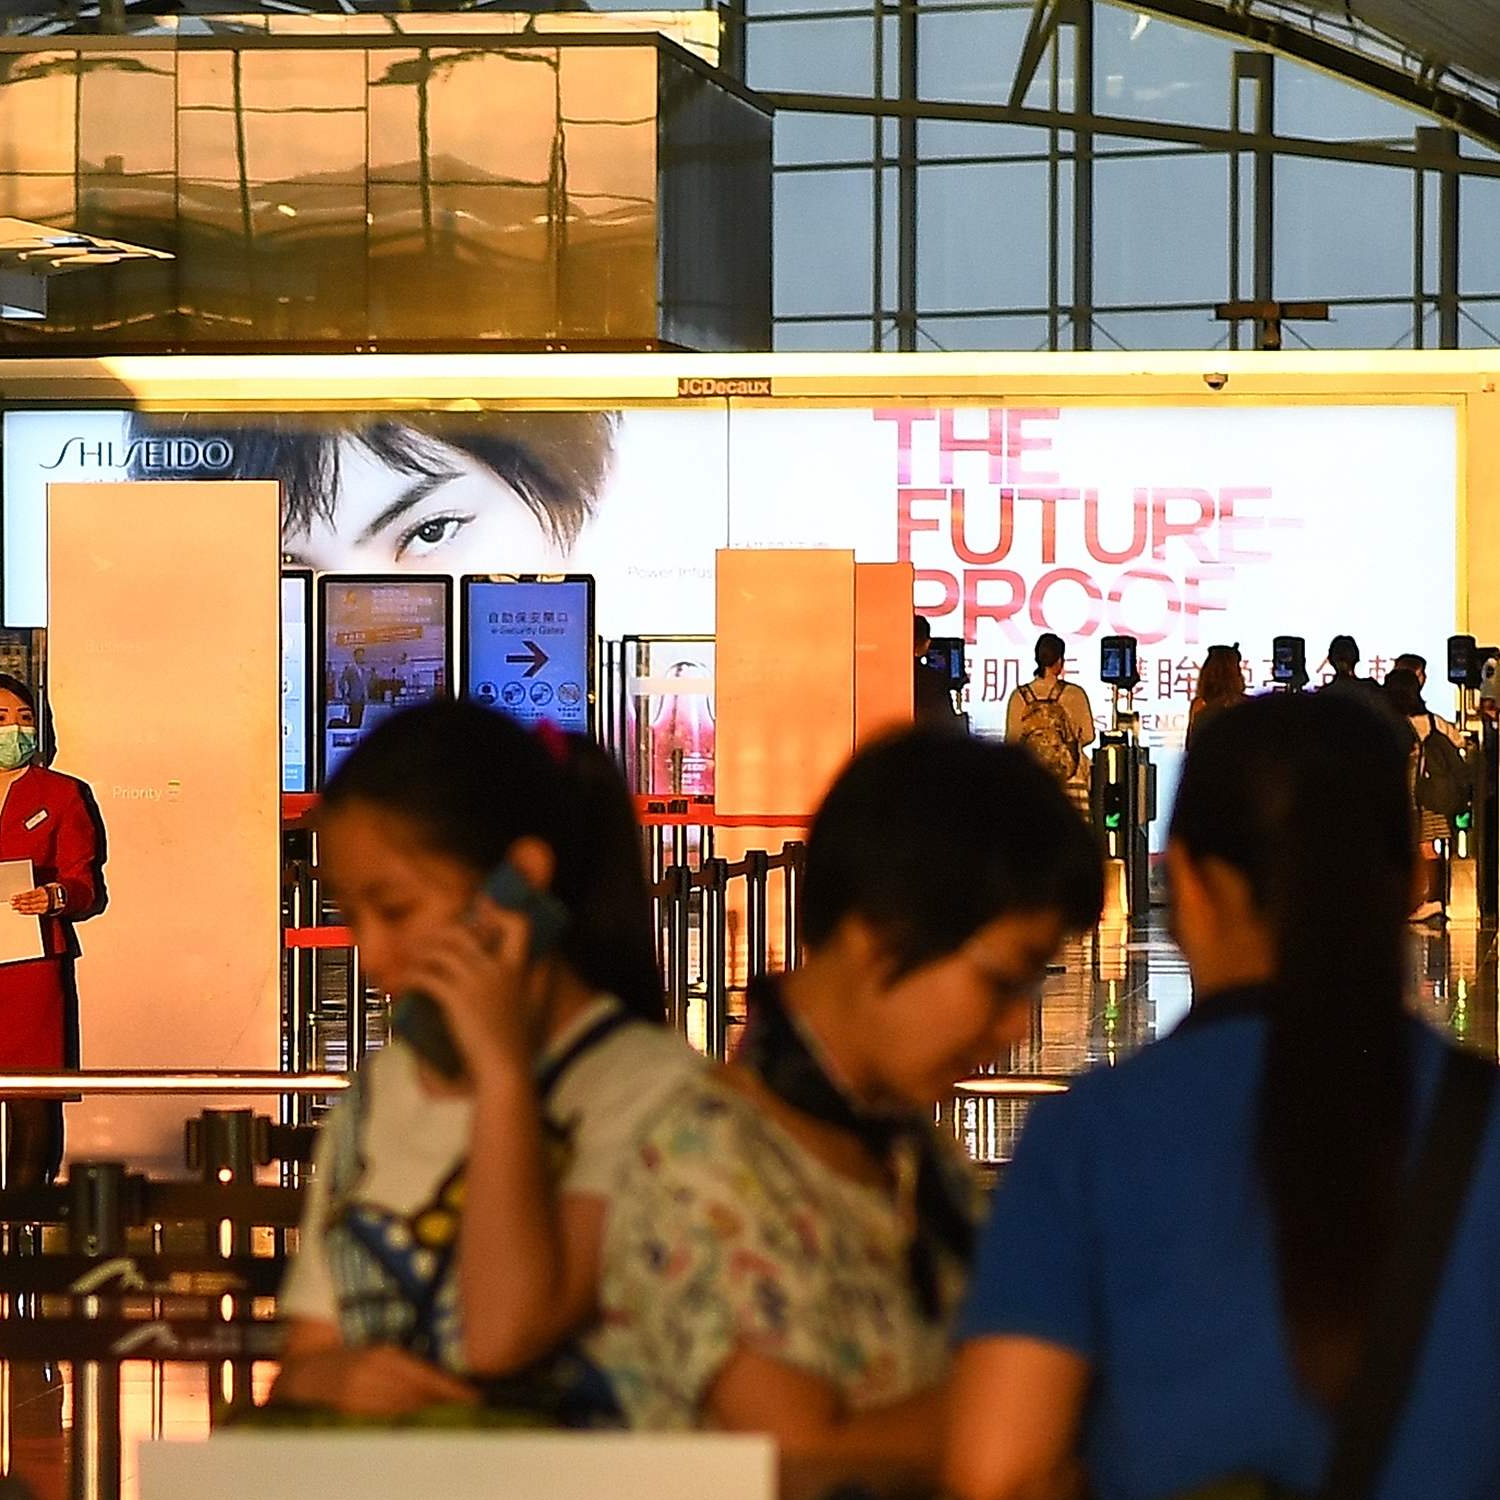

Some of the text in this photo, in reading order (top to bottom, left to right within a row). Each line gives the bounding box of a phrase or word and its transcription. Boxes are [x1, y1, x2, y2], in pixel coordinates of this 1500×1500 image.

[679, 379, 769, 395] JCDecaux
[39, 437, 231, 469] SHISEIDO
[872, 407, 1060, 485] THE
[914, 567, 1235, 645] PROOF
[112, 785, 162, 802] Priority
